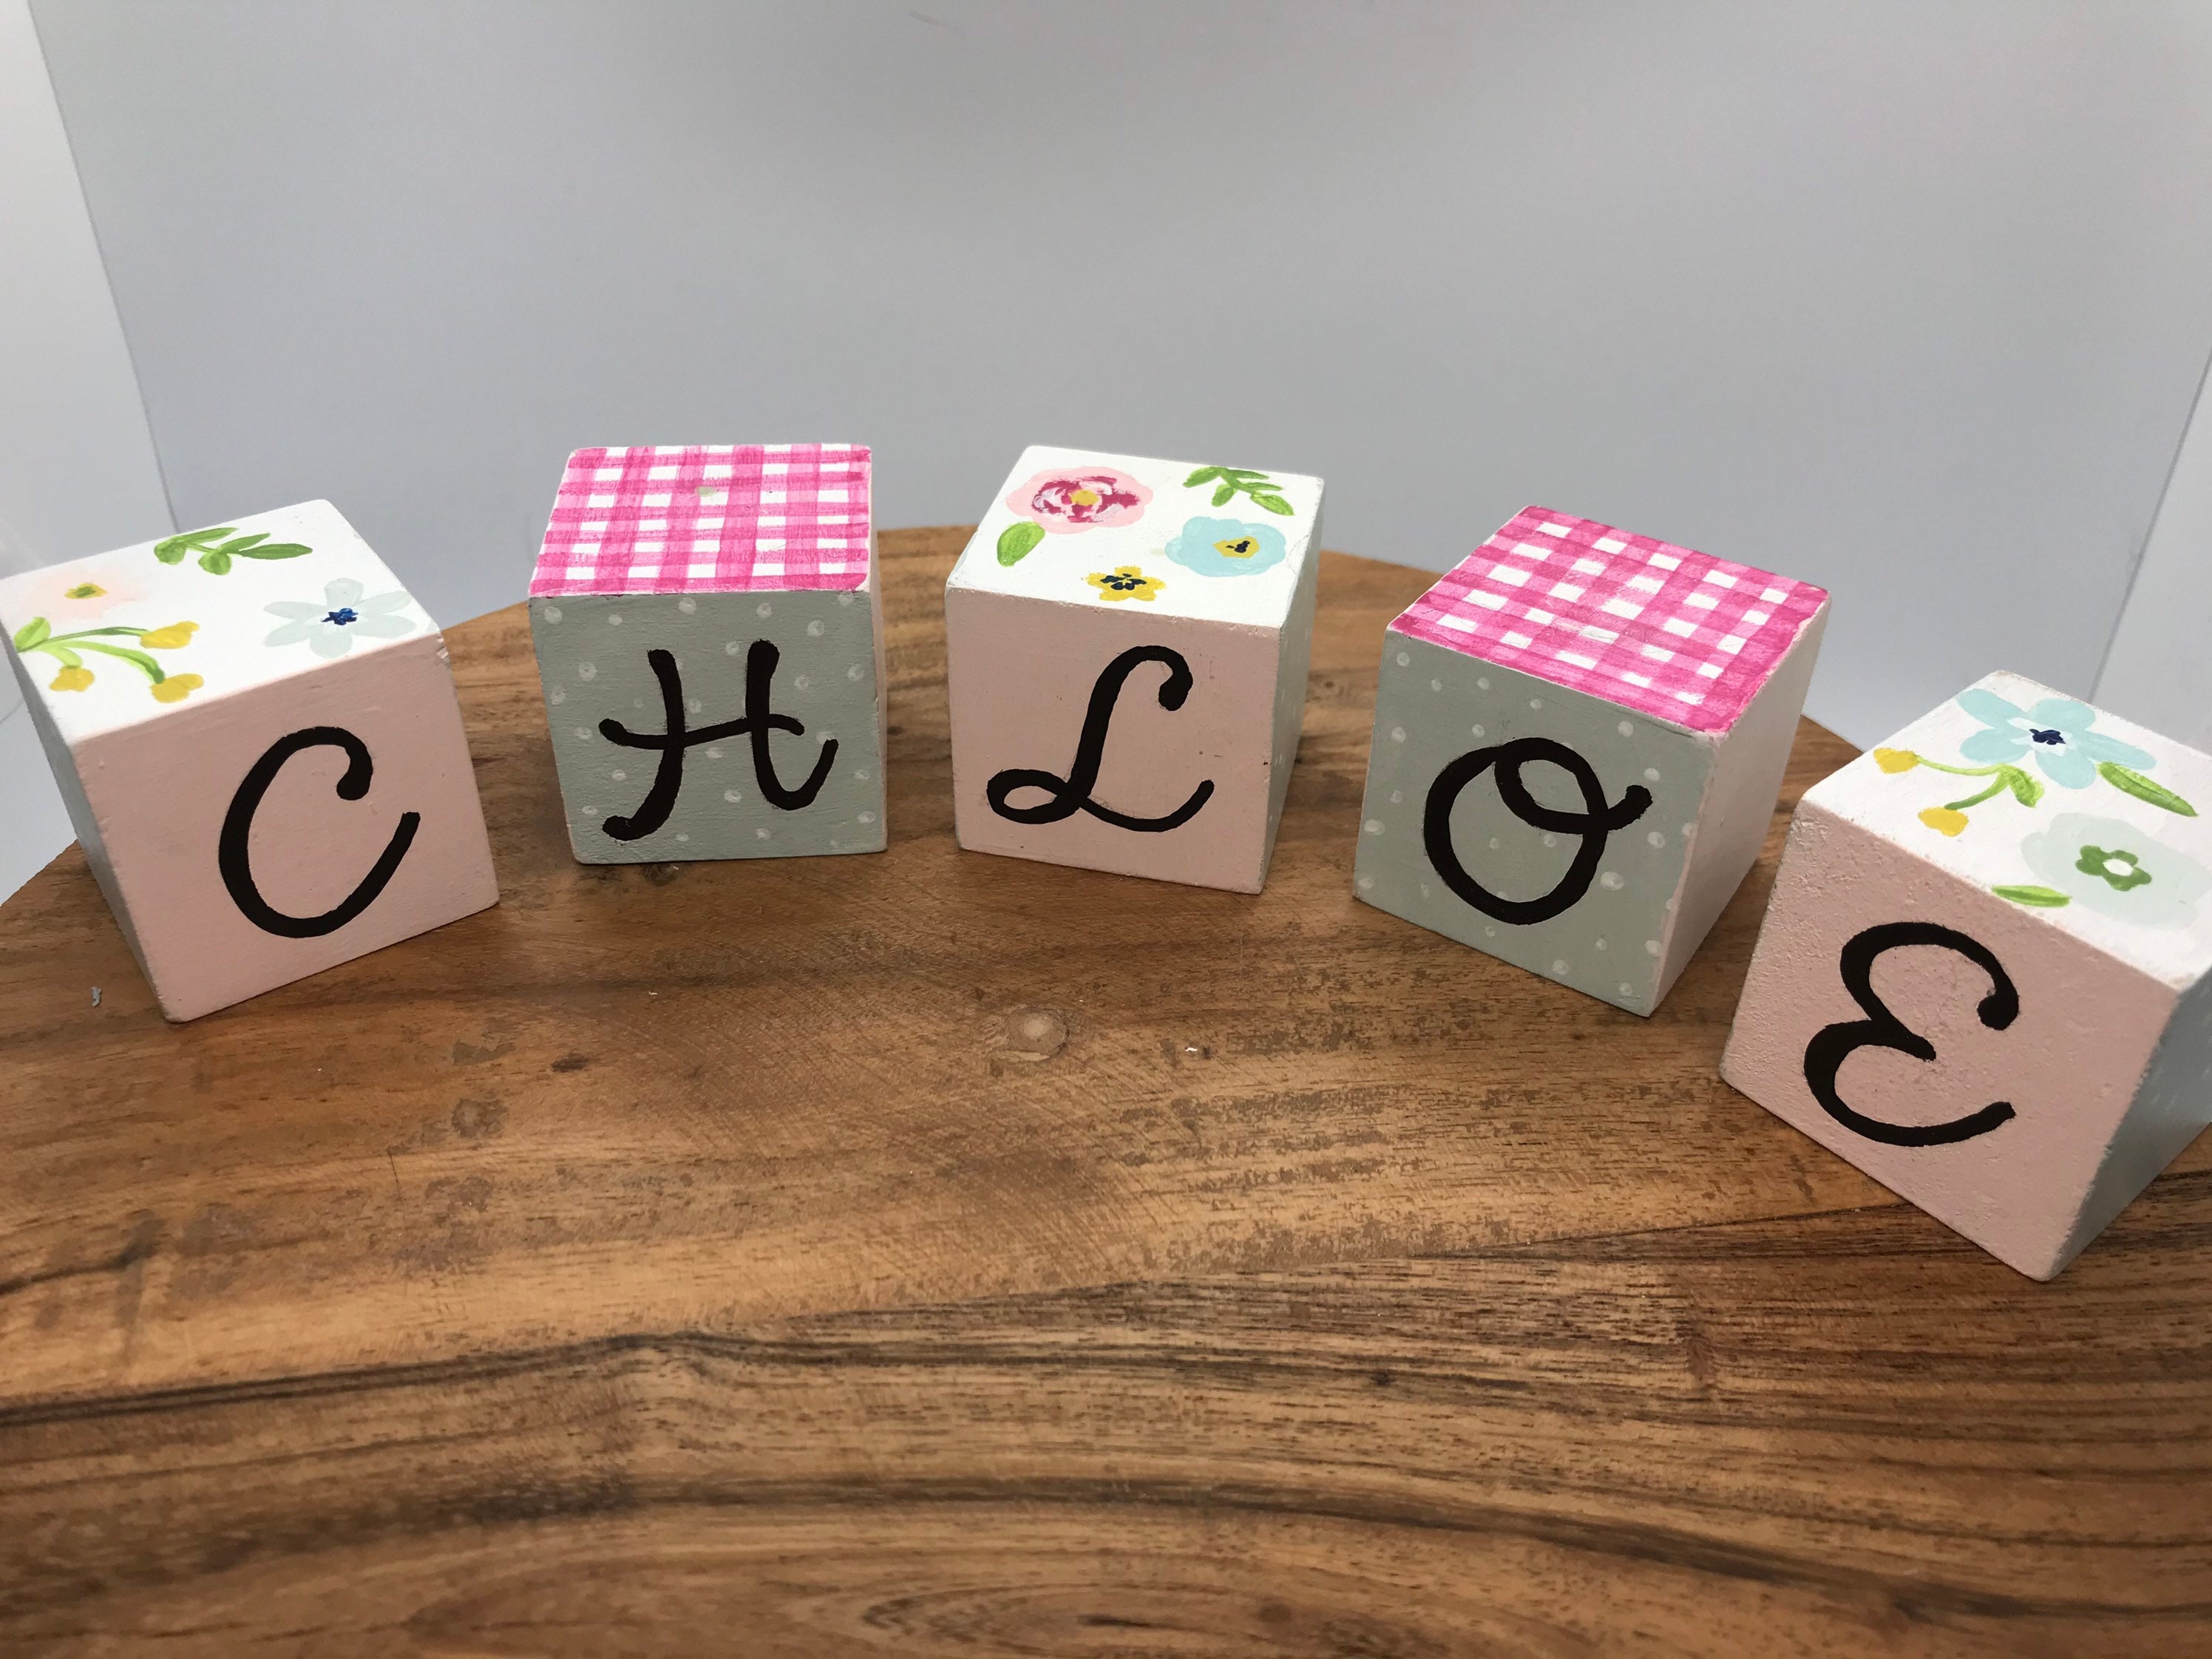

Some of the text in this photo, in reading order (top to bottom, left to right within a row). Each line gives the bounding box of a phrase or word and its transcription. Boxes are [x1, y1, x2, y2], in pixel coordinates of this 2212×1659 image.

[218, 726, 421, 939] C
[599, 639, 839, 841] H
[986, 645, 1215, 833] L
[1422, 736, 1654, 926] O
[1803, 921, 2020, 1147] E
